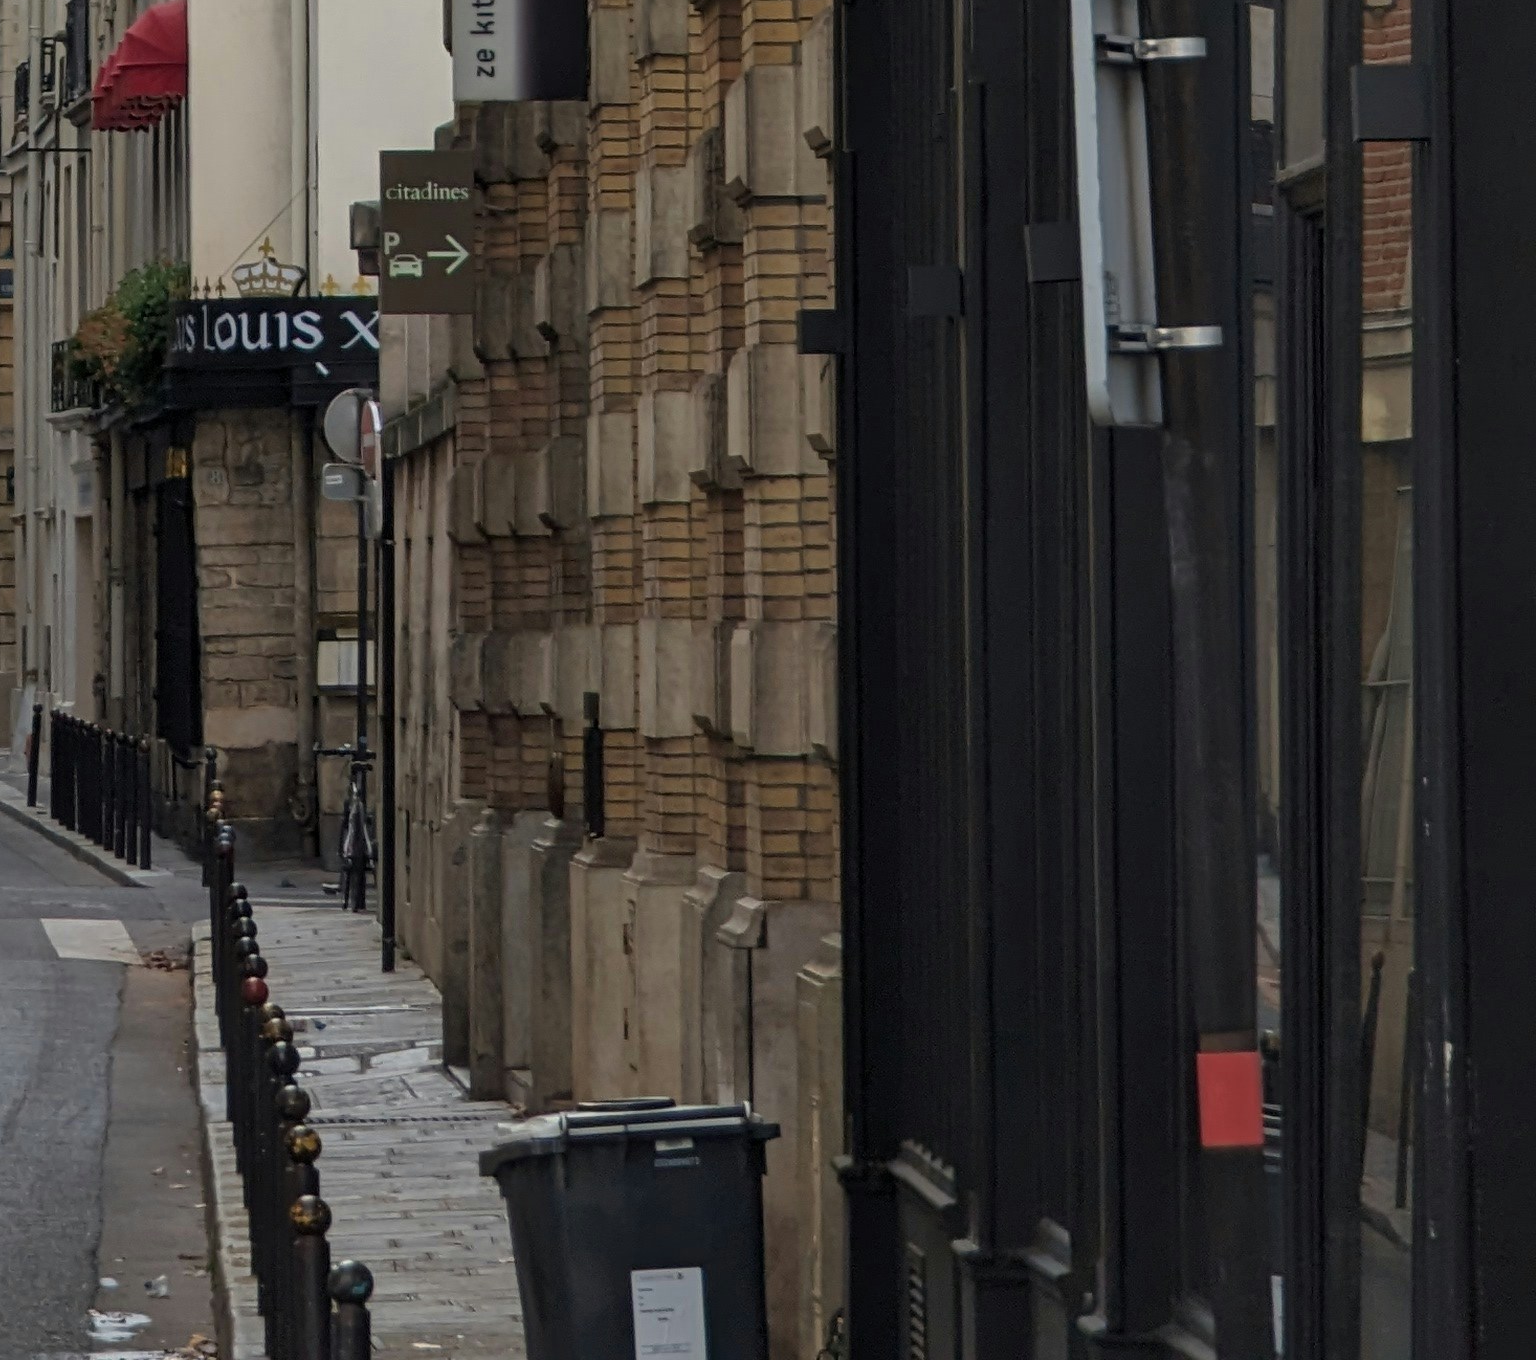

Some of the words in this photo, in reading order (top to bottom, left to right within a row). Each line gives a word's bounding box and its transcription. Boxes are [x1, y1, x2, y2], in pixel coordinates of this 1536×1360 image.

[476, 44, 495, 78] ze
[386, 182, 469, 200] citadines
[384, 232, 400, 255] P
